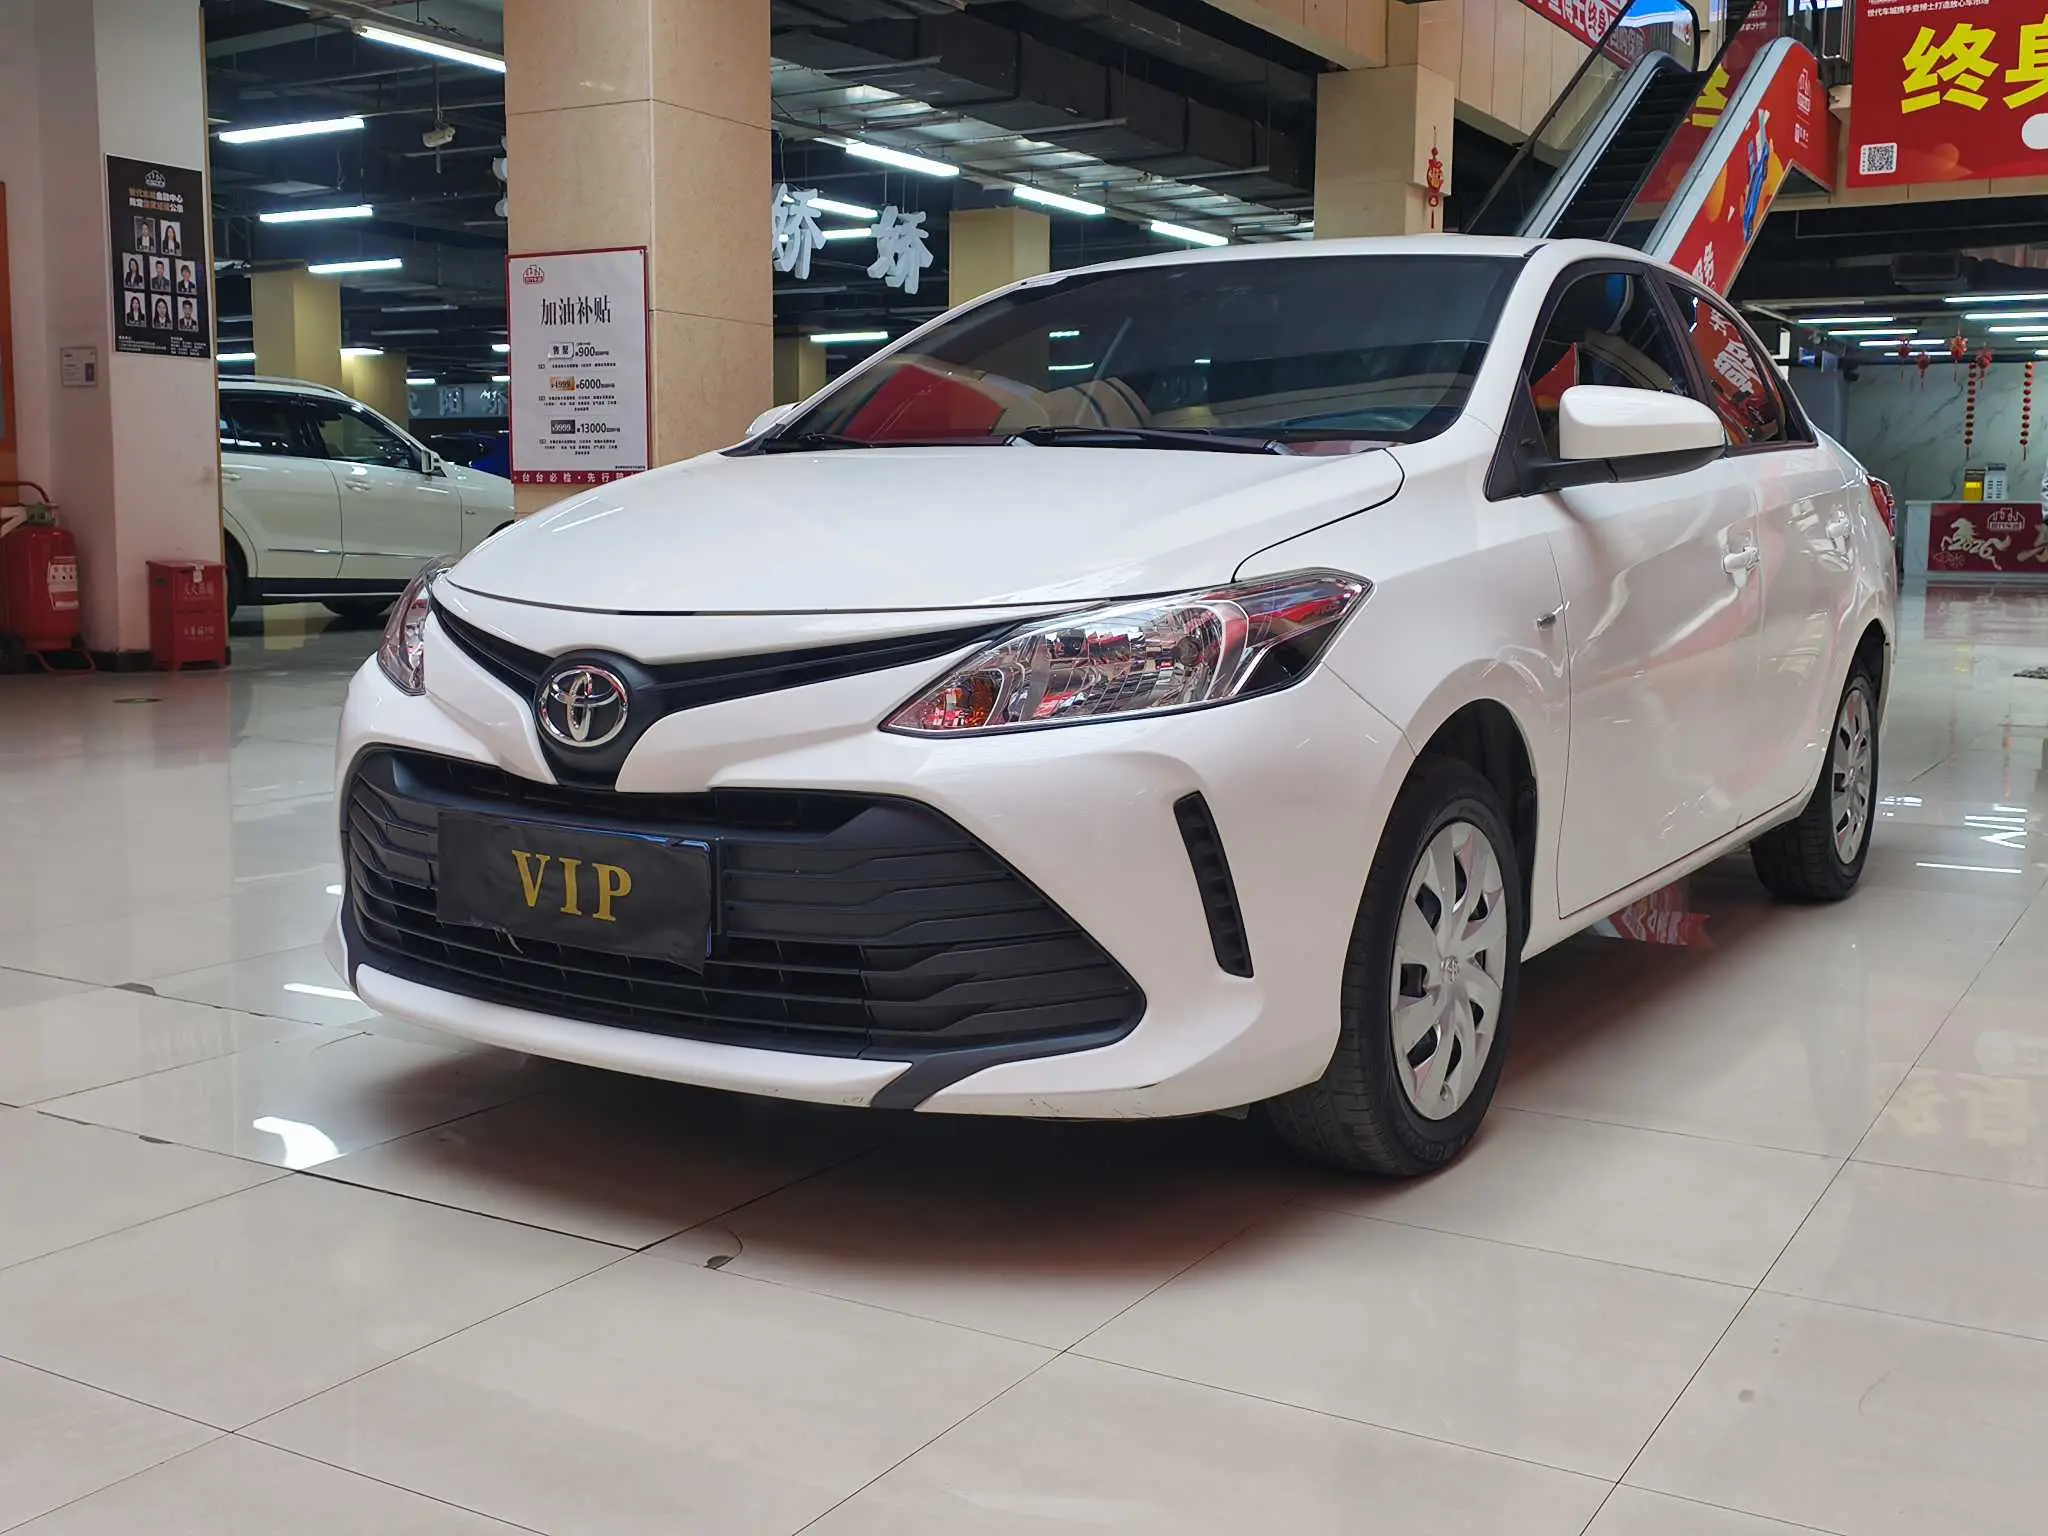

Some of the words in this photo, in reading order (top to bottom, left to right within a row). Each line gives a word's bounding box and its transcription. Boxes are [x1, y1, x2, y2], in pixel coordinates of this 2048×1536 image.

[541, 295, 612, 326] 加油补贴
[512, 849, 632, 922] VIP
